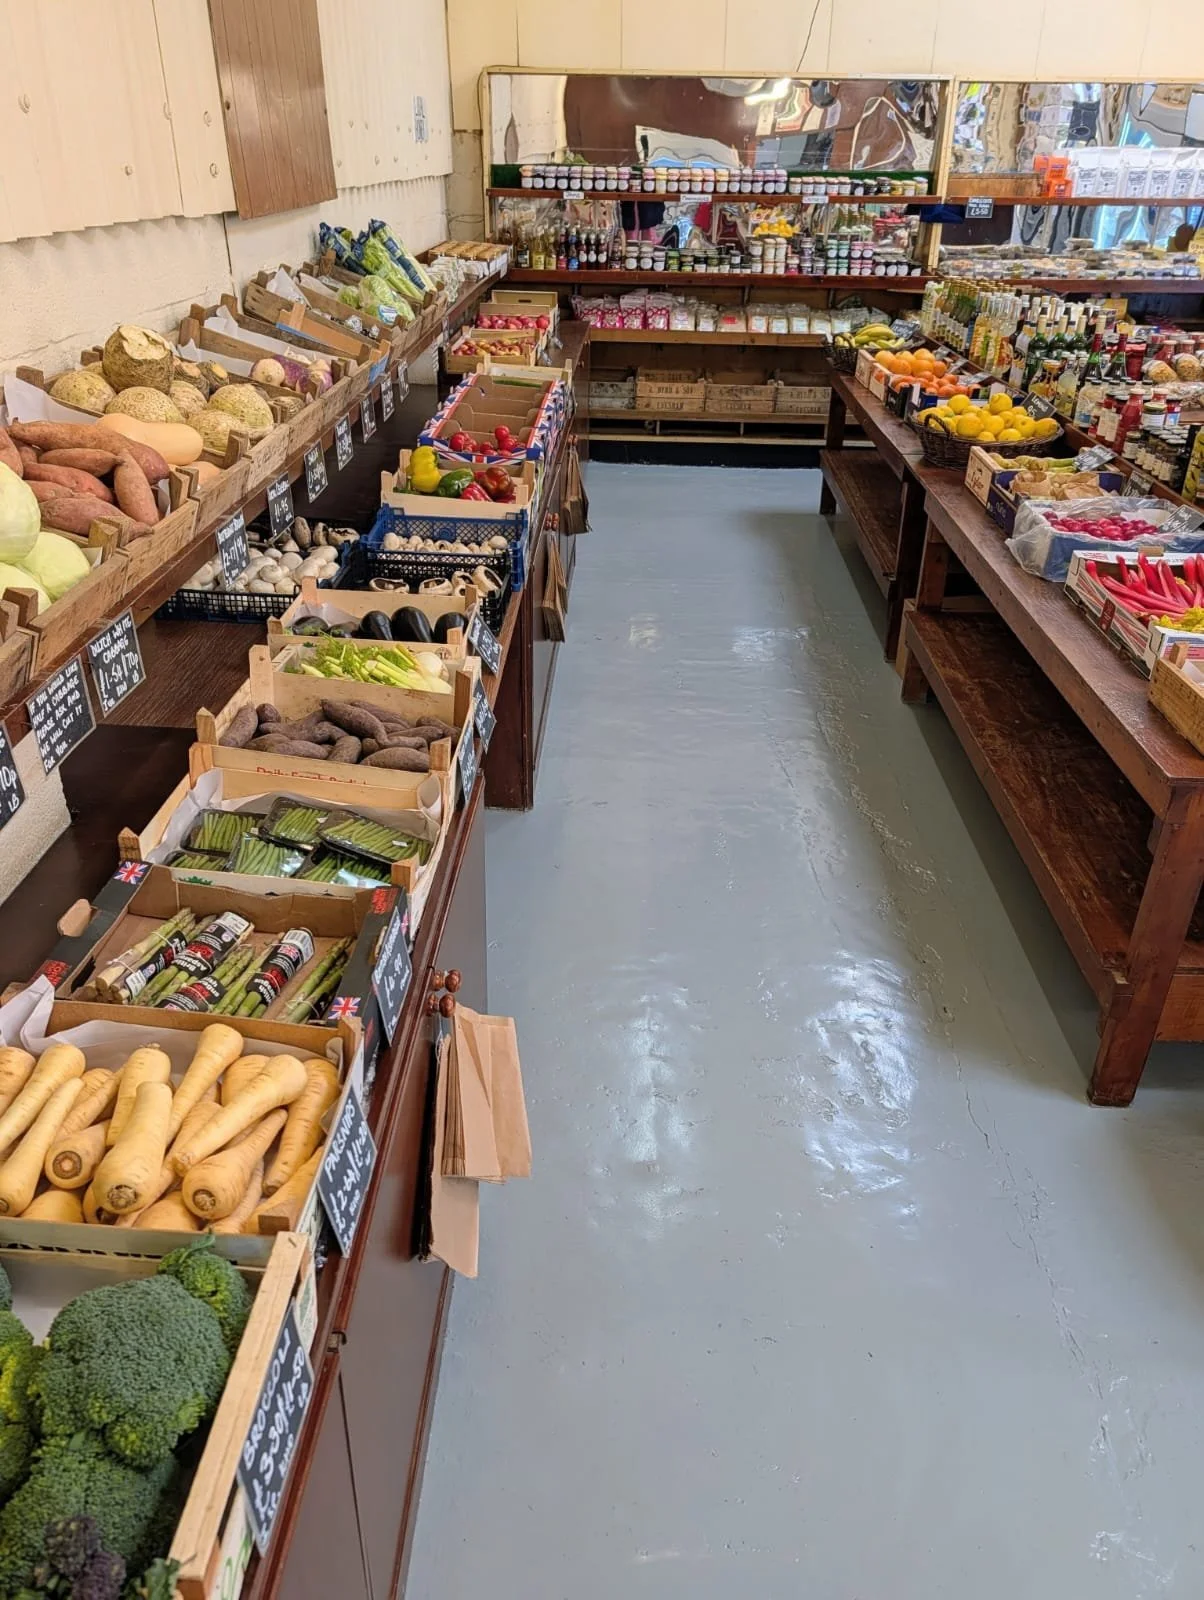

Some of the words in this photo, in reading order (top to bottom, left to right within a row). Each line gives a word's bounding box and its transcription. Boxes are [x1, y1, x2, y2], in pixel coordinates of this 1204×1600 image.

[90, 637, 112, 658] DUTCH
[29, 702, 35, 716] IF
[36, 692, 48, 708] YOU
[49, 676, 65, 697] WOULD
[32, 713, 44, 730] HALF
[46, 705, 52, 715] A
[52, 676, 80, 706] CABBAGE
[36, 719, 55, 744] PLEASE
[55, 705, 67, 722] ASK
[40, 741, 50, 758] WE
[50, 727, 63, 745] WILL
[62, 712, 75, 729] CUT
[75, 703, 84, 718] IT
[8, 793, 19, 812] LB
[324, 1097, 356, 1183] PARSNIPS
[243, 1327, 291, 1471] BROCCOLI
